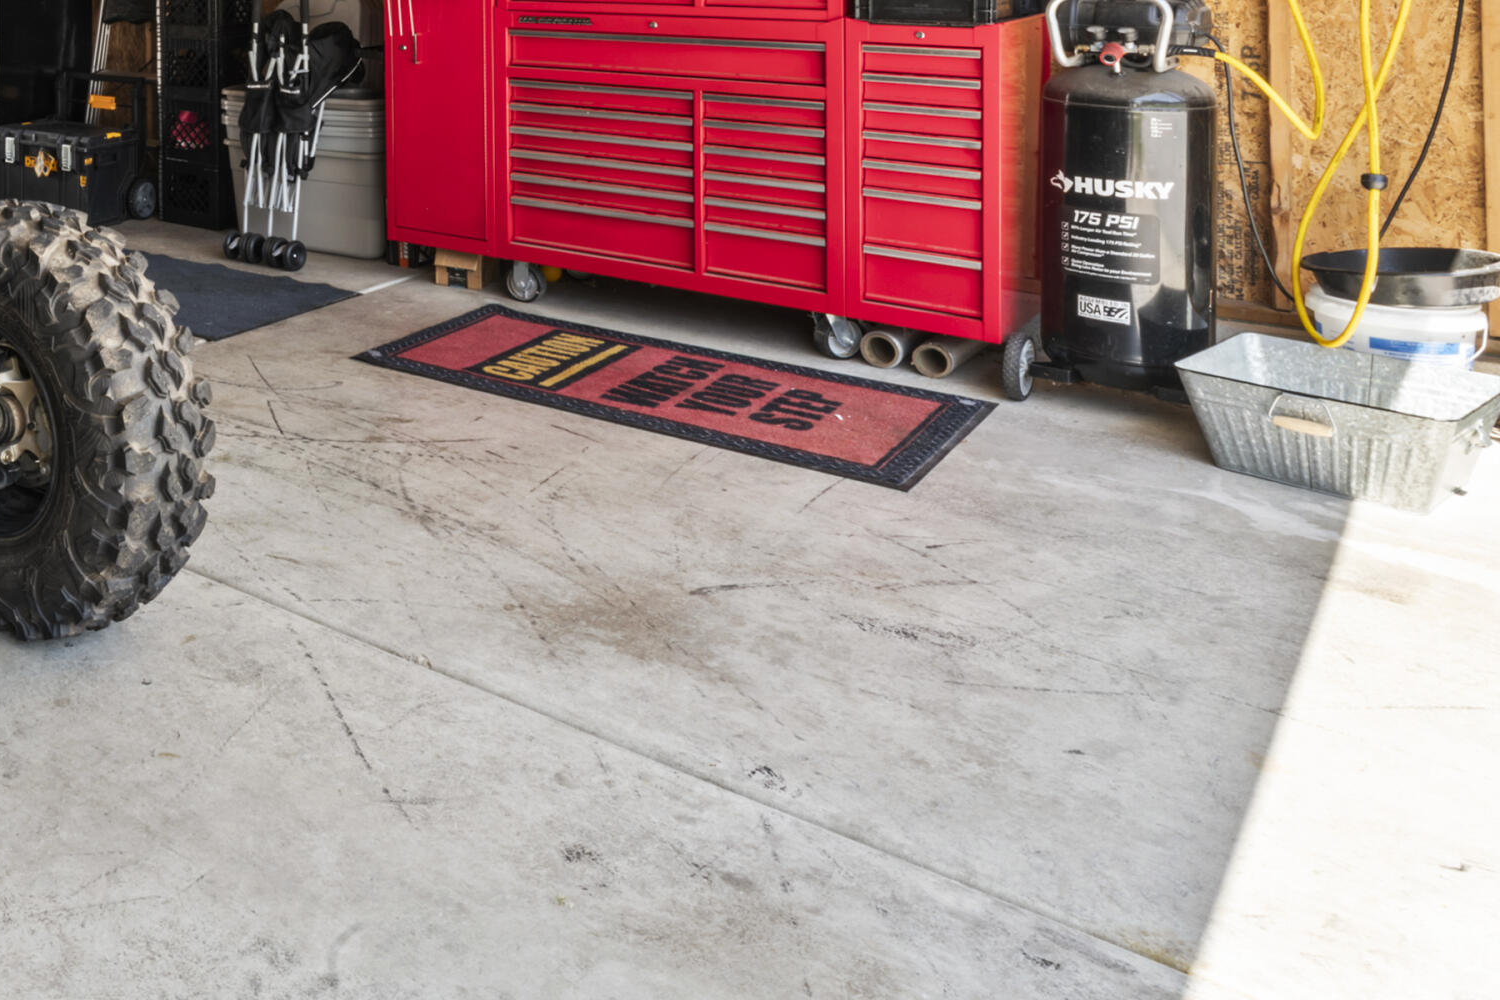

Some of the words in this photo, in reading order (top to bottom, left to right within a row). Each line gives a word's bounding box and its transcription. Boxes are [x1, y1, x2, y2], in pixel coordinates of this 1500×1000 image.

[1074, 176, 1175, 200] HUSKY
[1074, 210, 1102, 226] 175
[1105, 214, 1140, 230] PSI
[1080, 301, 1101, 315] USA
[483, 332, 606, 381] CAUTION
[601, 356, 726, 409] WATCH
[675, 373, 781, 416] YOUR
[748, 388, 844, 432] STEP
